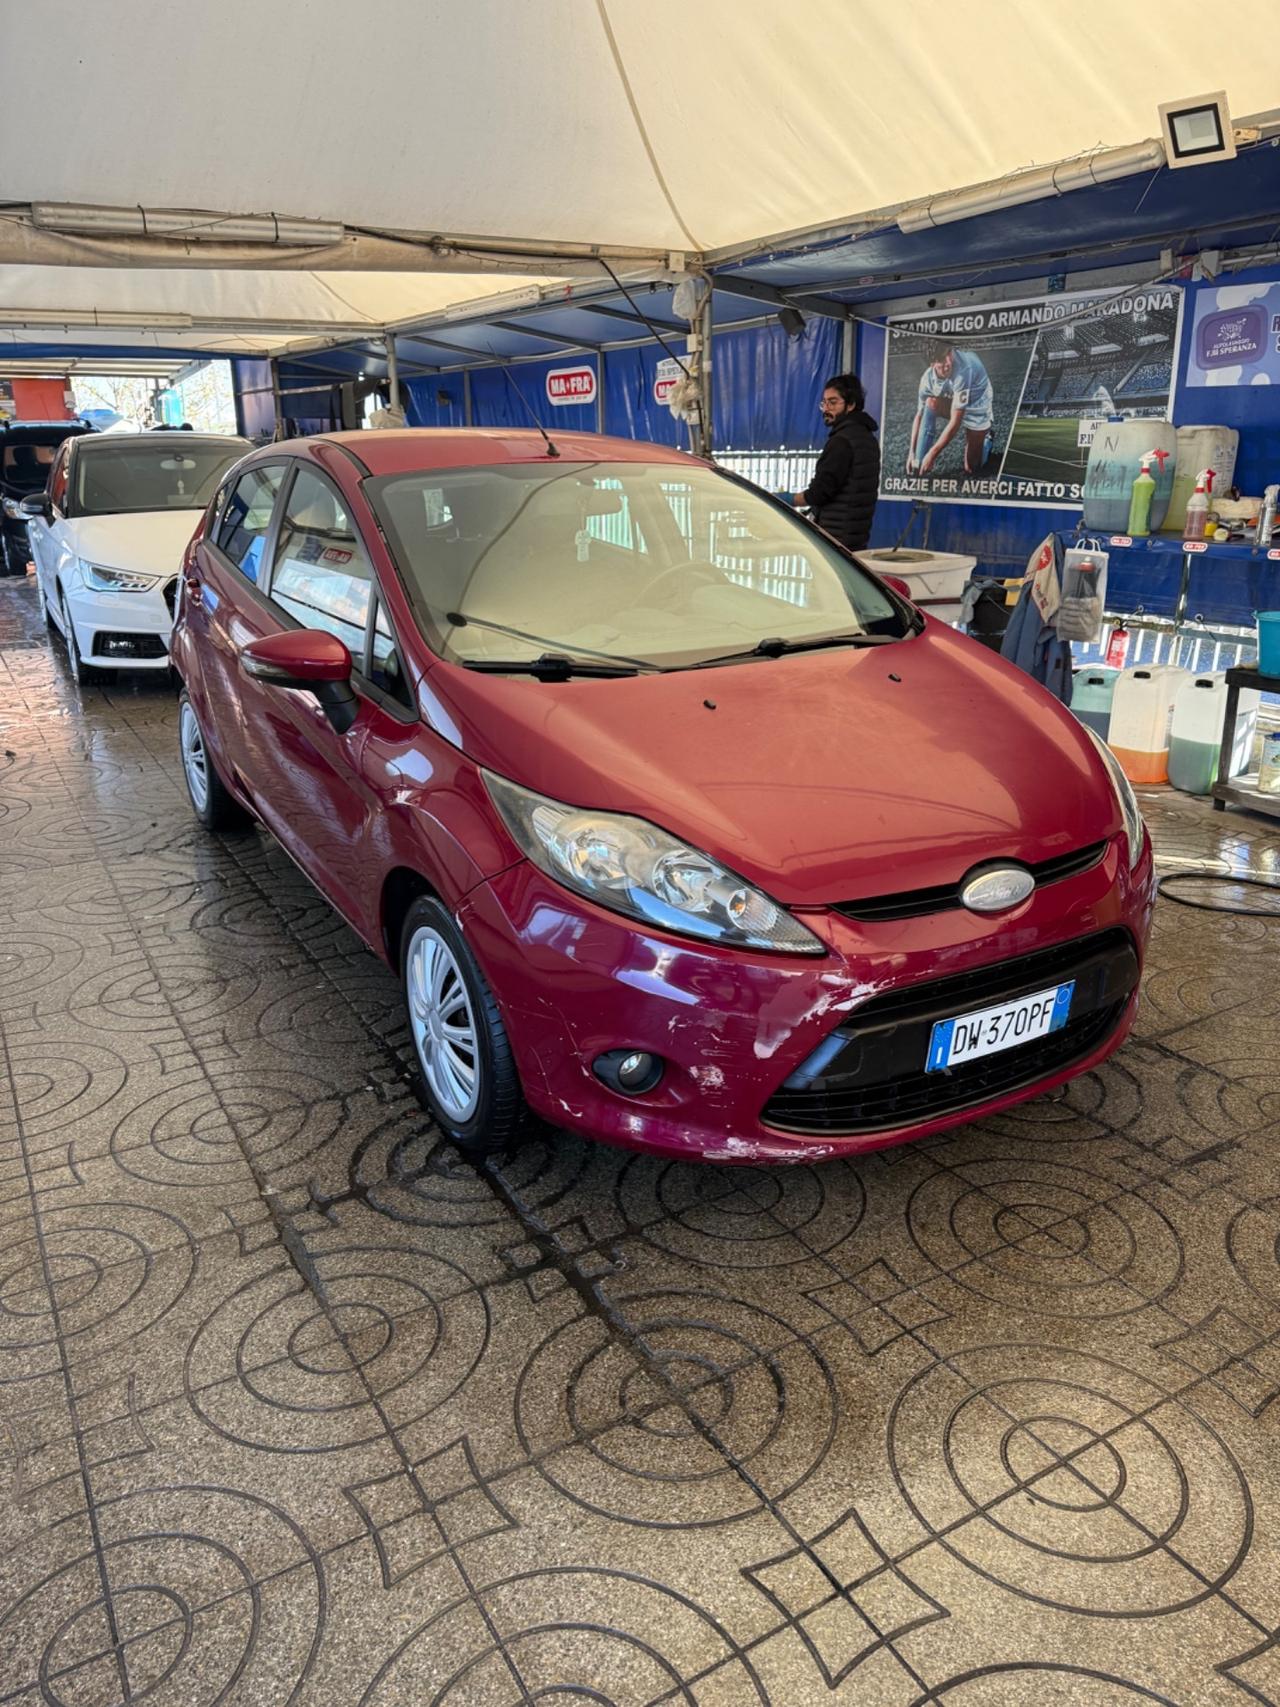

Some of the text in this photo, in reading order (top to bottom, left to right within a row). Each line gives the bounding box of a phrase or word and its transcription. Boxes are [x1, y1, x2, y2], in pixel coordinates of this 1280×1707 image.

[942, 315, 984, 333] DIEGO
[988, 305, 1066, 328] ARMANDO
[1071, 292, 1174, 318] MARADONA
[1219, 342, 1257, 355] SPERANZA
[885, 478, 929, 493] GRAZIE
[932, 478, 958, 494] PER
[961, 479, 1013, 495] AVERCI
[1017, 482, 1066, 498] FATTO
[986, 997, 1055, 1046] 370PF
